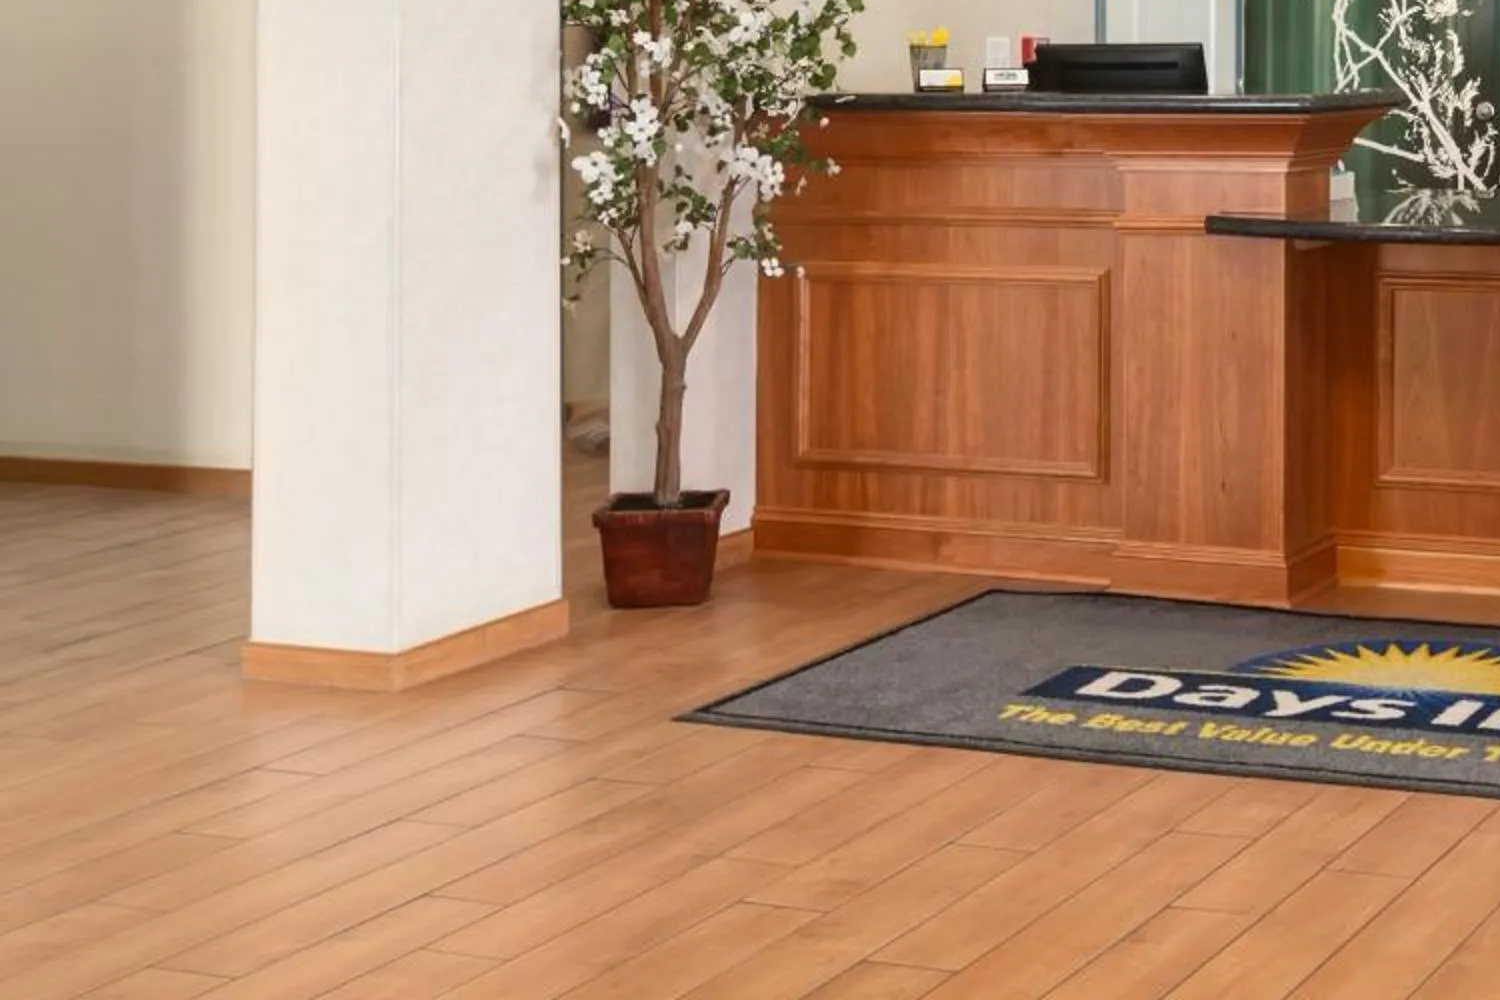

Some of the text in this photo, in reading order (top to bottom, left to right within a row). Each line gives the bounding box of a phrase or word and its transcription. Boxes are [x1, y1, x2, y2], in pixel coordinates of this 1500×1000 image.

[1073, 671, 1416, 720] Days
[999, 703, 1076, 725] The
[1082, 712, 1189, 736] Best
[1199, 721, 1318, 747] Value
[1330, 733, 1471, 760] Under
